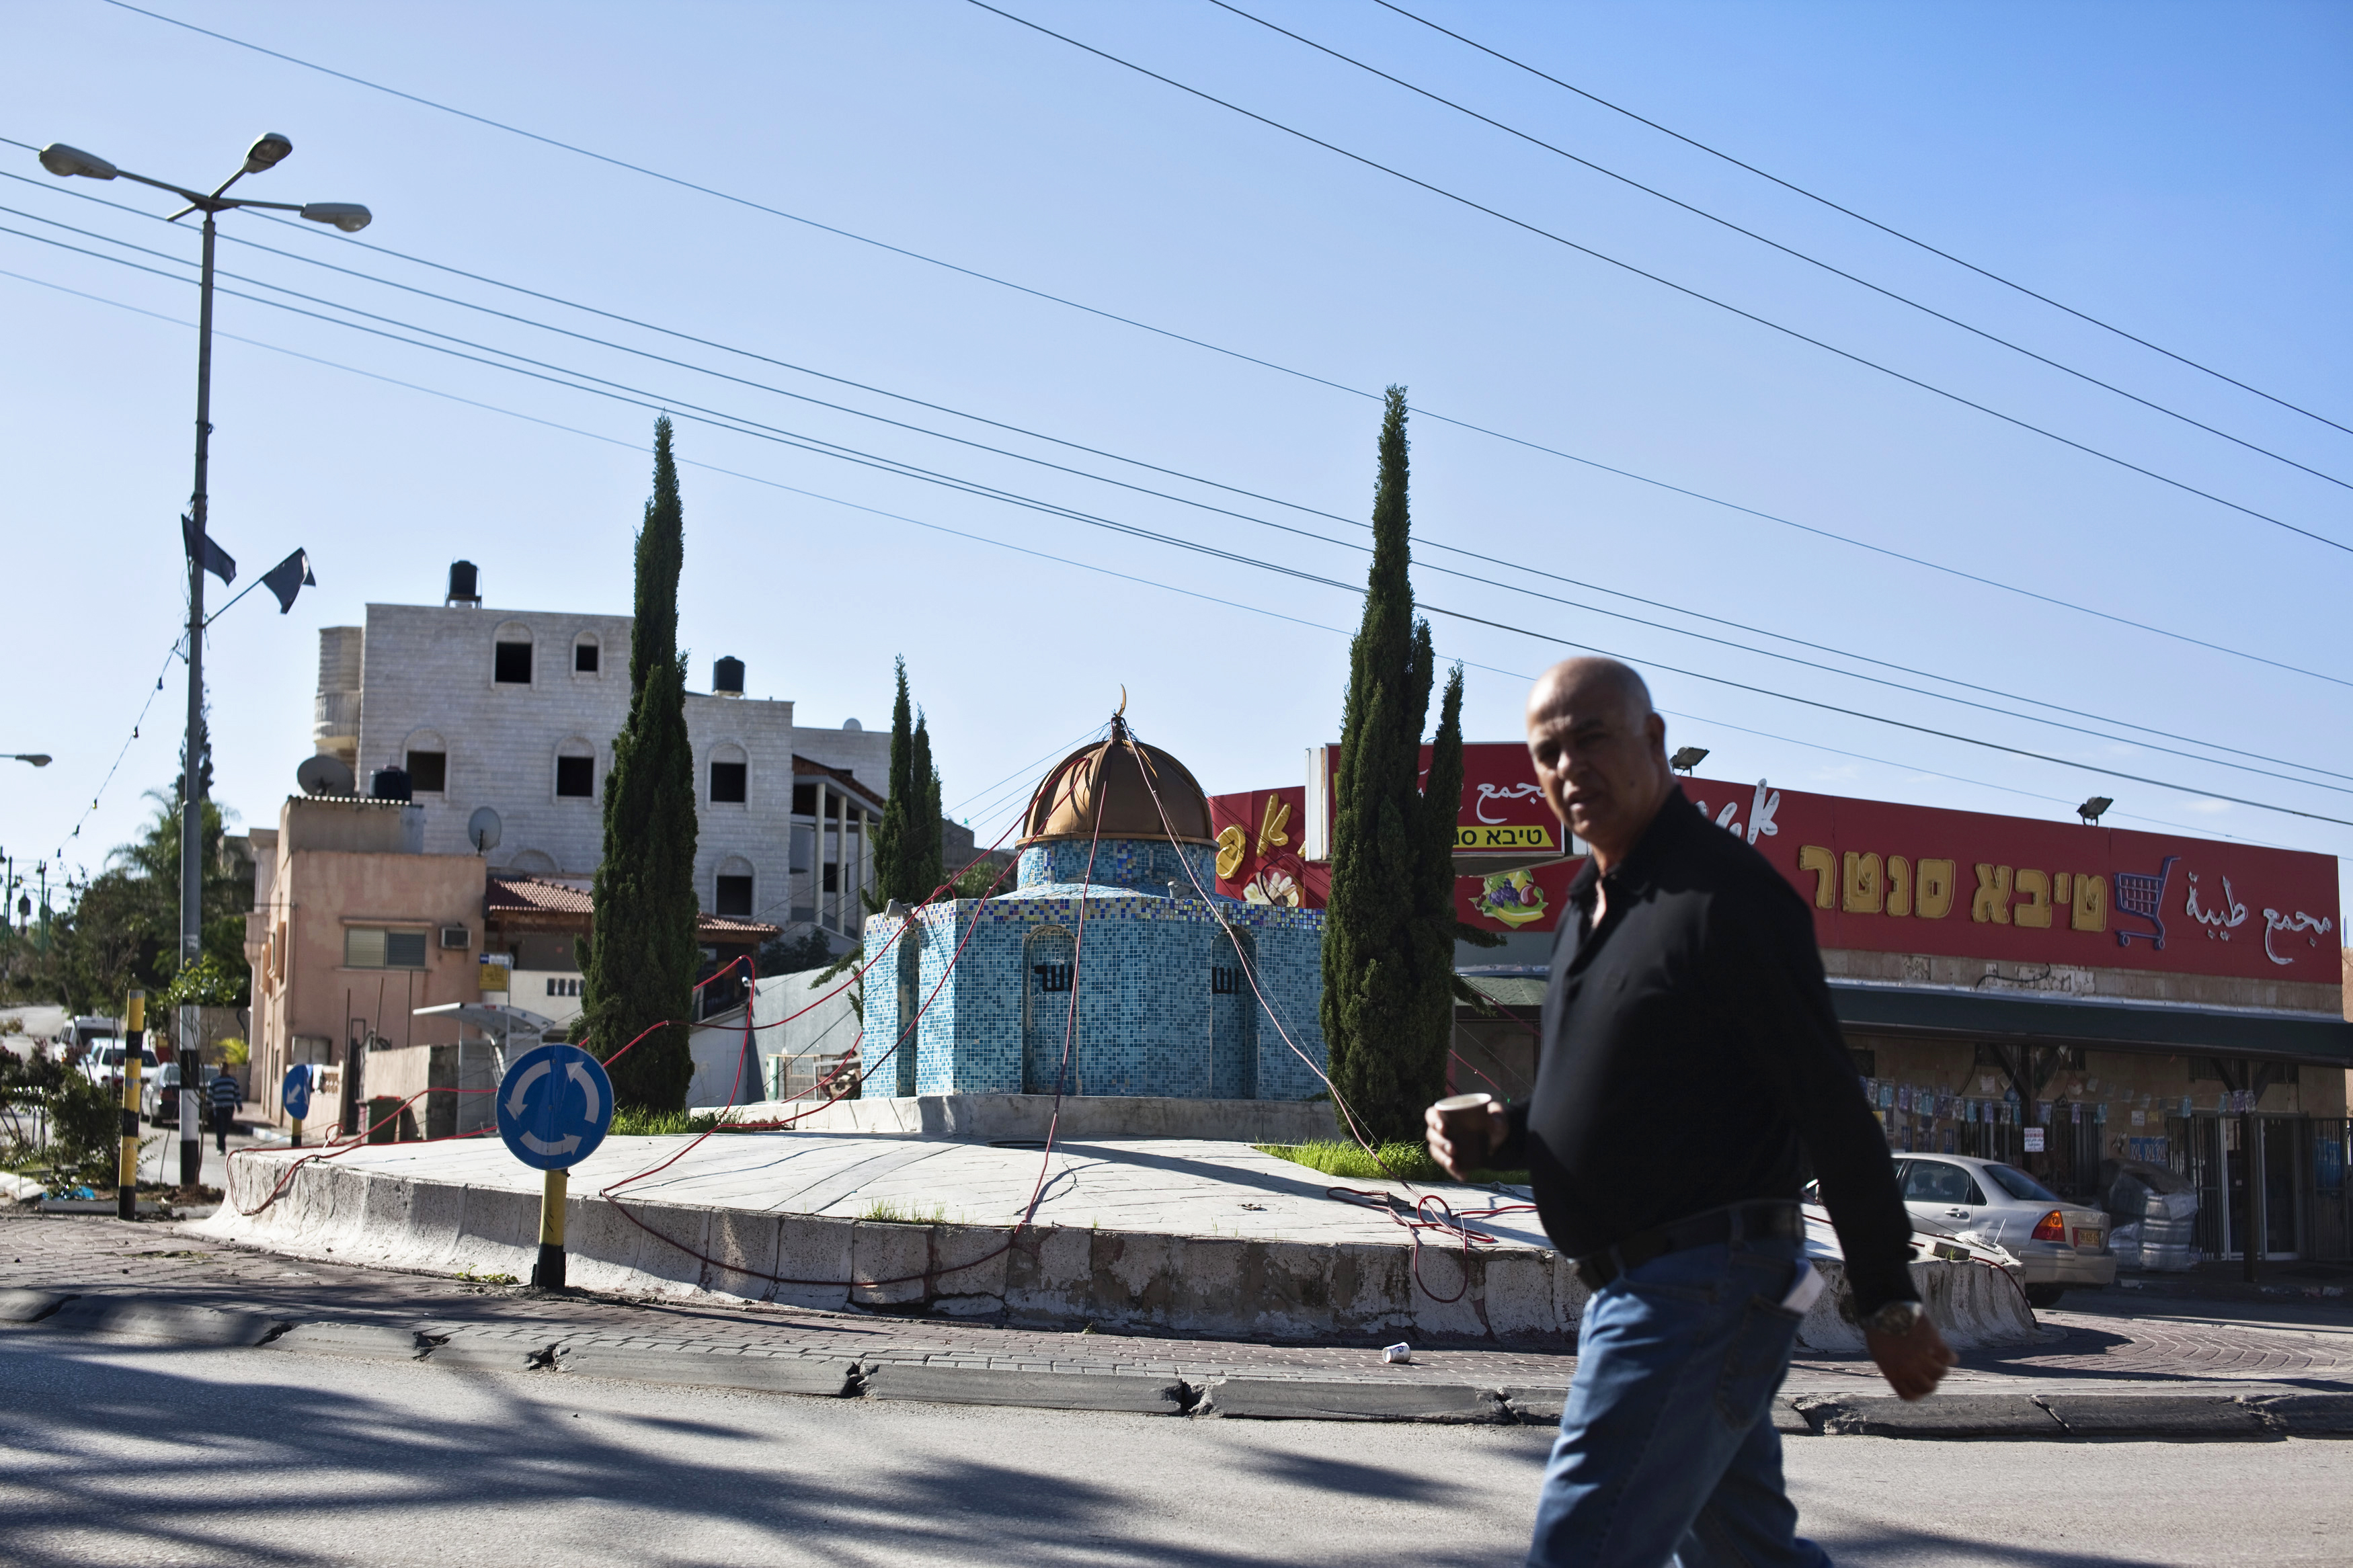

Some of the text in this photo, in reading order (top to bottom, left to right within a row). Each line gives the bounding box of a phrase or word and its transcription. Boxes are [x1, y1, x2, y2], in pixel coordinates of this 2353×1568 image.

[1486, 829, 1542, 845] טיבא
[1799, 845, 2108, 932] טיבא סנטר
[2186, 871, 2332, 965] مجمع طيبة
[2130, 1144, 2167, 1161] XL XL XL
